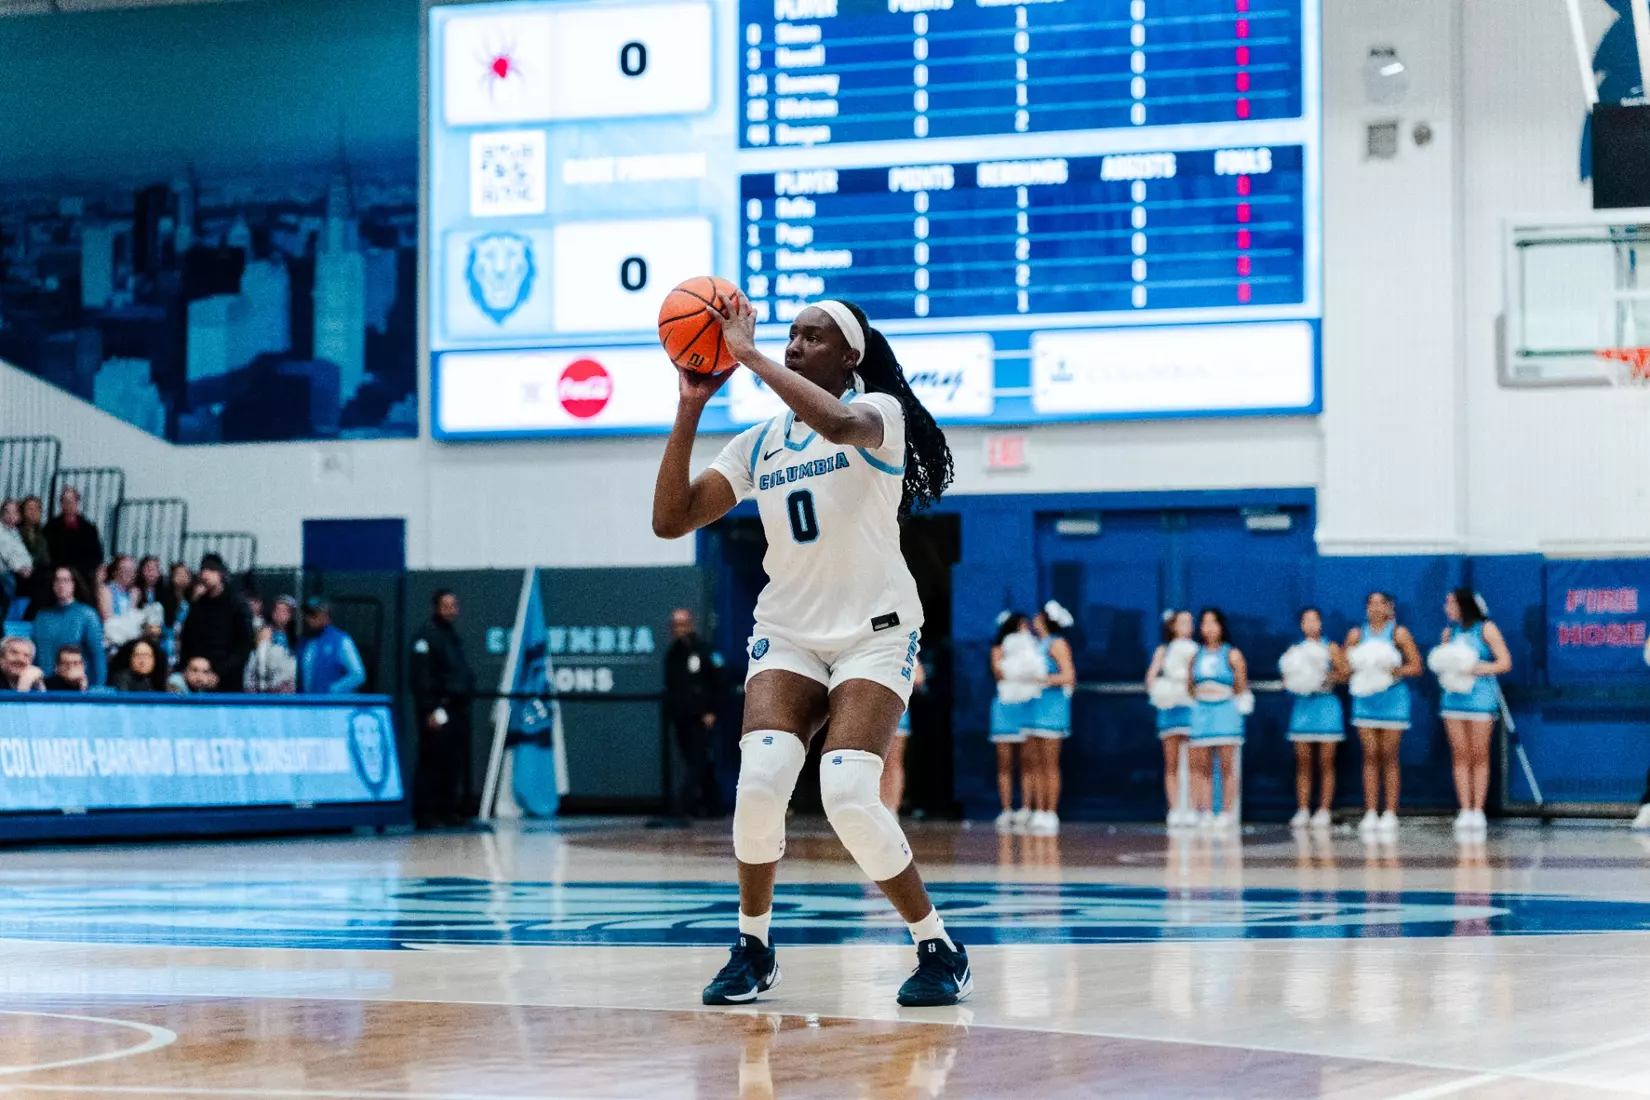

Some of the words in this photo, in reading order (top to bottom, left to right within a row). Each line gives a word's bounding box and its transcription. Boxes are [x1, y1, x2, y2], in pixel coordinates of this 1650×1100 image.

[620, 41, 647, 77] 0
[774, 169, 839, 195] PLAYER
[888, 165, 955, 192] POINTS
[1214, 147, 1272, 176] FOULS
[620, 256, 647, 292] 0
[786, 488, 820, 544] 0
[1566, 588, 1638, 613] FIRE
[1558, 621, 1646, 647] HOSE
